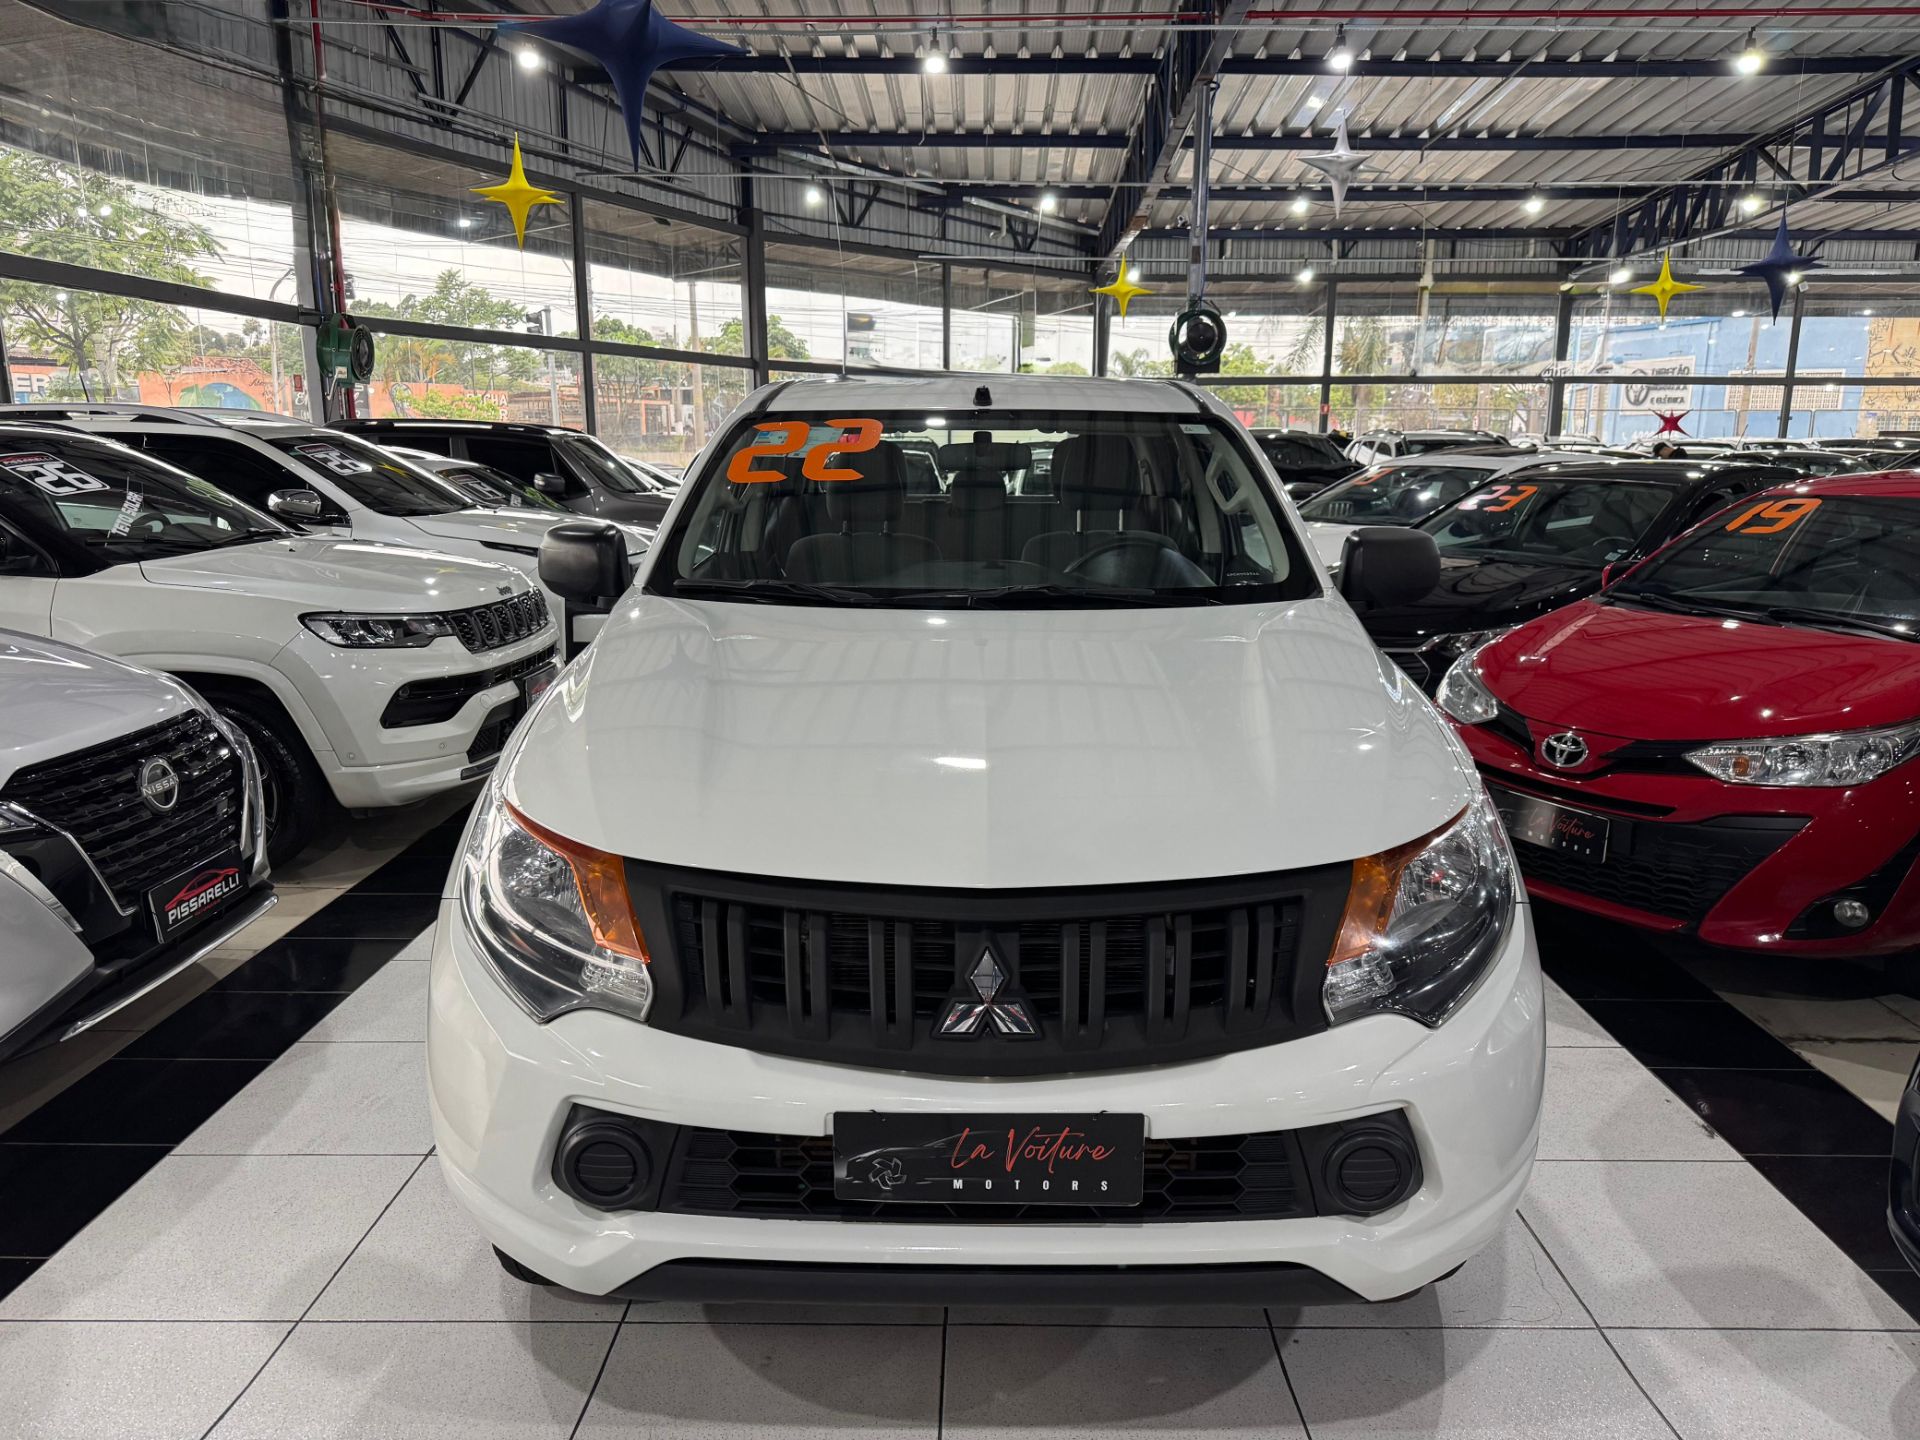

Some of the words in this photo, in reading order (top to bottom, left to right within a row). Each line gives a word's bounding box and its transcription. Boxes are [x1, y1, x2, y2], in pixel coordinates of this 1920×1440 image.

[726, 418, 884, 484] 22
[16, 462, 104, 493] 26
[1457, 485, 1538, 512] 23
[1725, 498, 1823, 534] 19
[142, 773, 180, 795] NISSAN
[168, 872, 240, 925] PISSARELLI
[951, 1127, 995, 1169] La
[1005, 1125, 1116, 1174] Voiture
[952, 1178, 1109, 1192] MOTORS
